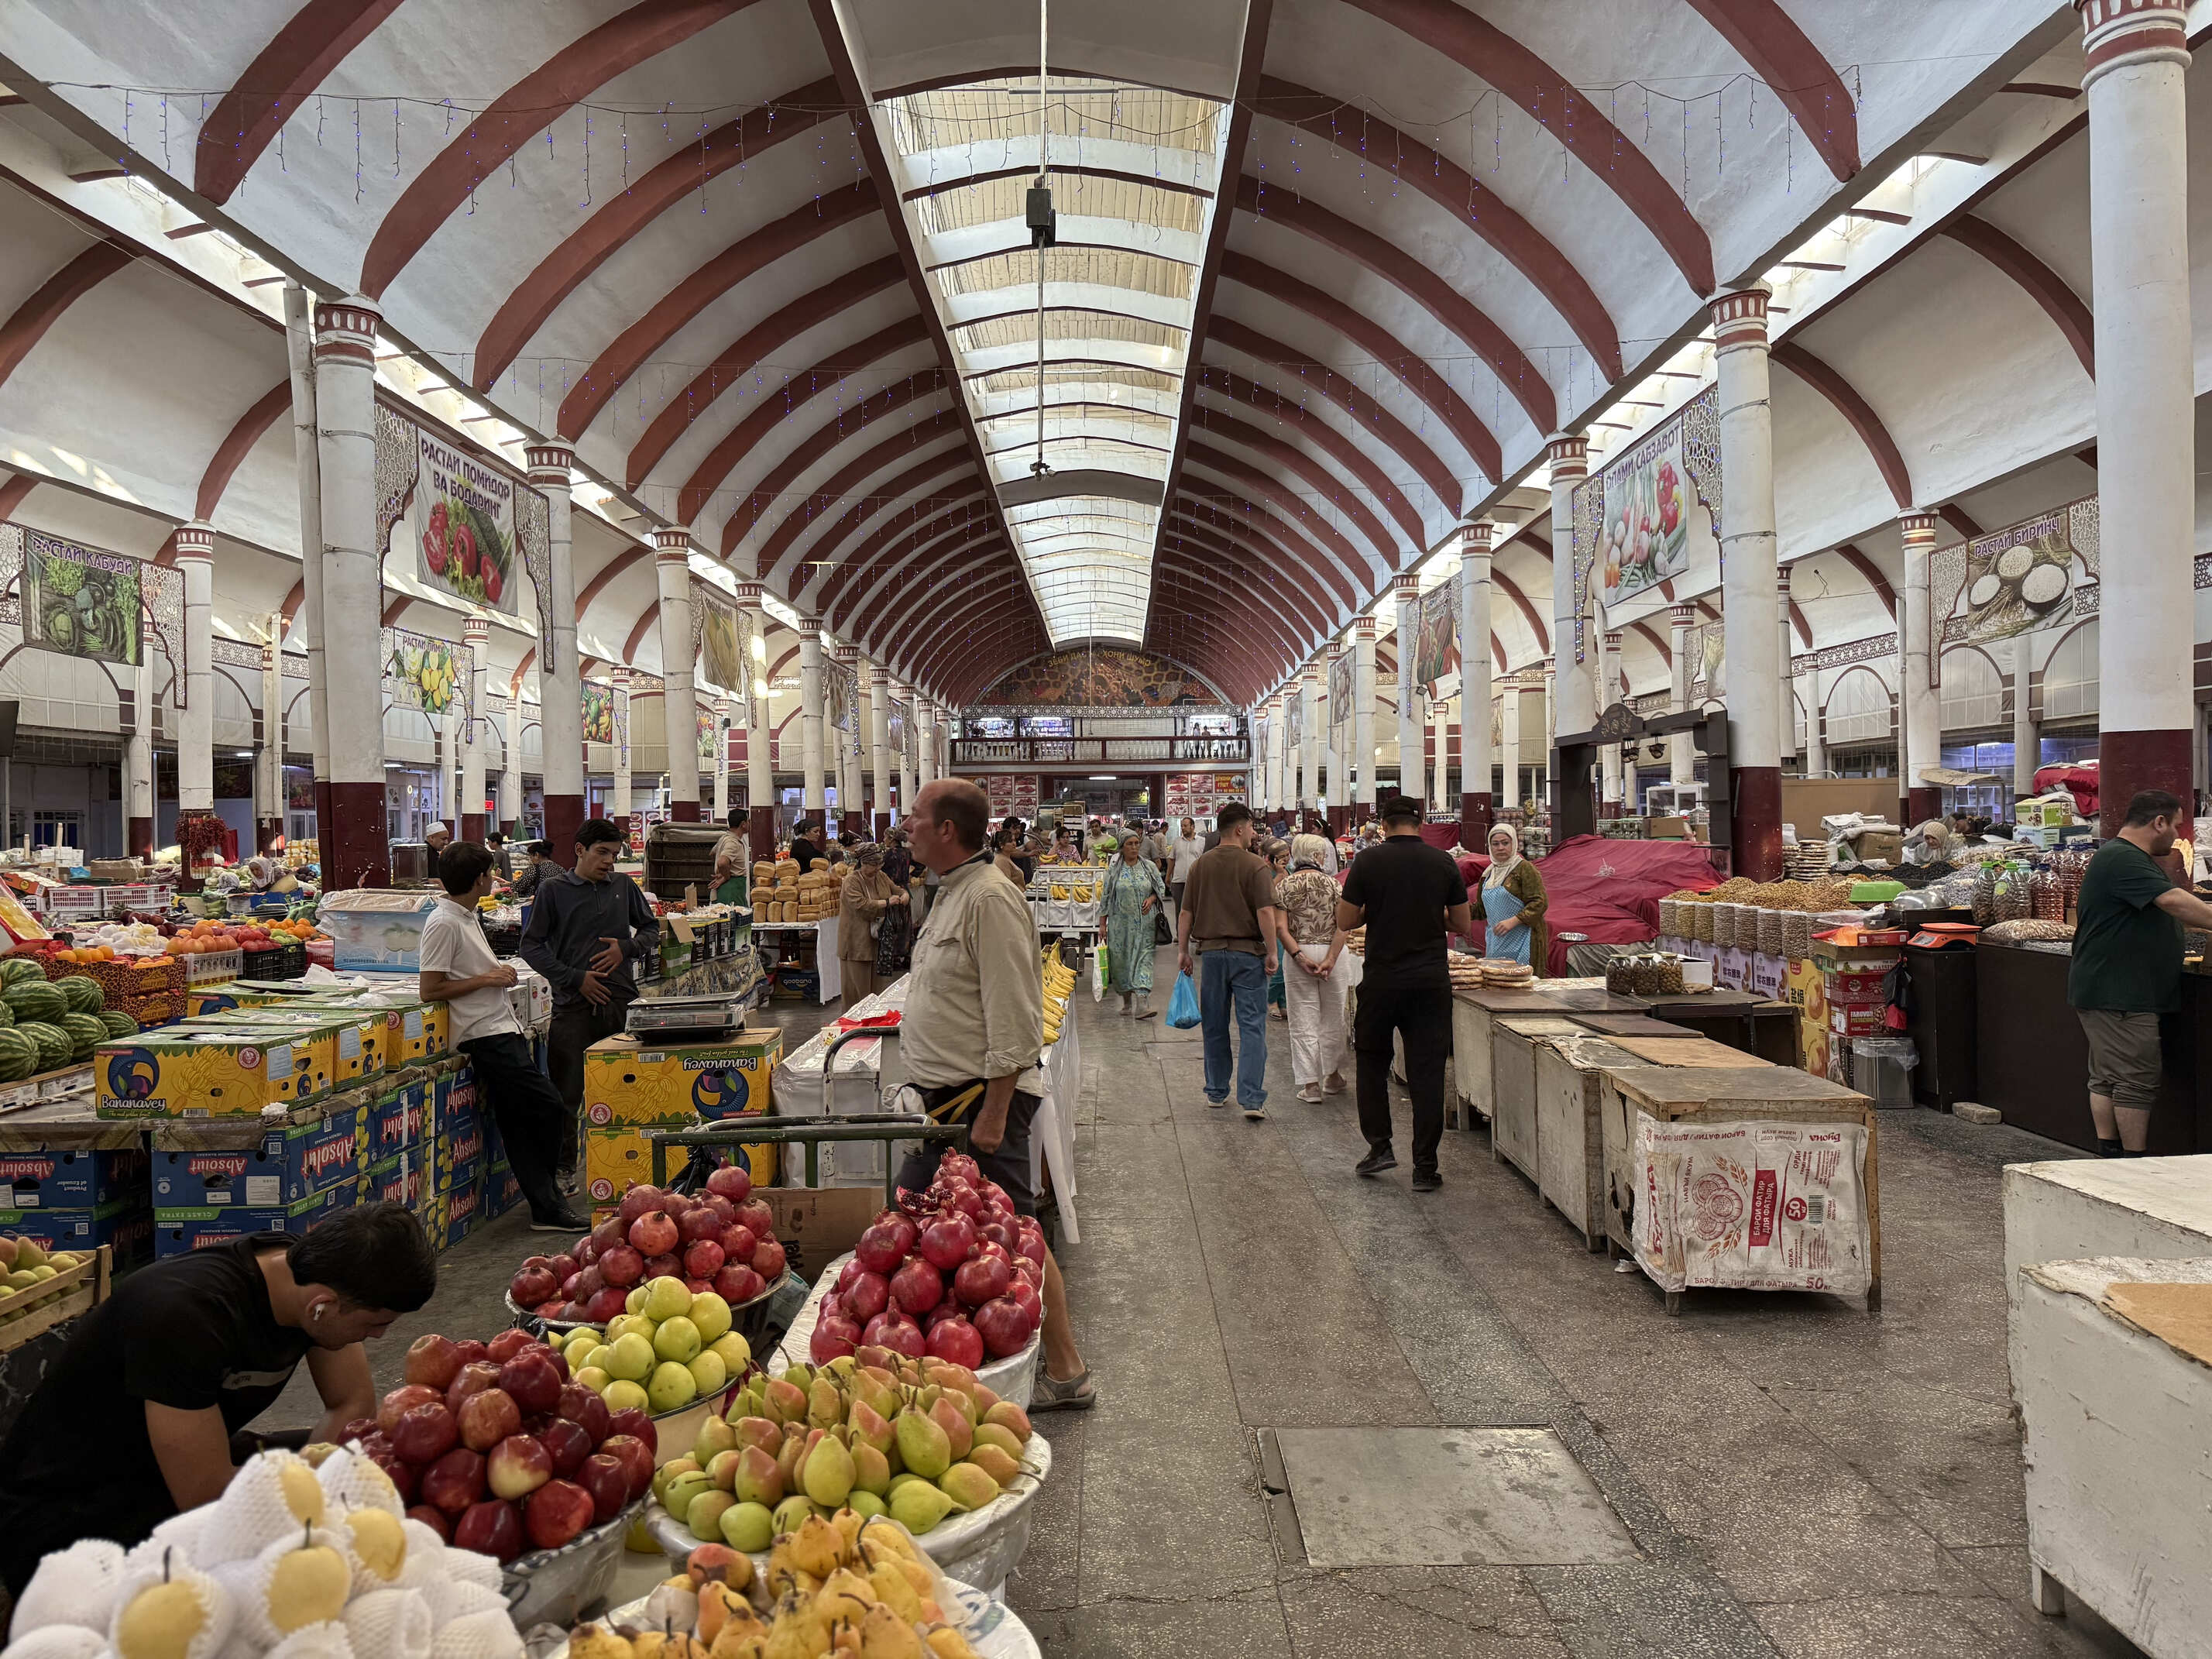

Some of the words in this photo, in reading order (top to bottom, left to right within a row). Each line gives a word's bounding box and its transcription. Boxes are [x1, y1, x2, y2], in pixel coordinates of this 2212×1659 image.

[1636, 424, 1680, 470] САБЗАВОТ
[462, 460, 510, 500] ПОМИДОР
[433, 469, 448, 493] ВА
[450, 477, 502, 520] БОДАРИНГ
[683, 1056, 757, 1071] Bananavey
[101, 1095, 167, 1111] Bananavey
[1721, 1130, 1746, 1140] БАРОИ
[1809, 1132, 1841, 1143] Буона
[191, 1159, 246, 1173] Absolut
[1755, 1180, 1765, 1207] ФАТИР
[1764, 1182, 1774, 1216] ФАТЫРА
[1788, 1200, 1801, 1218] 50
[1753, 1210, 1762, 1236] БАРОИ
[1762, 1218, 1772, 1234] ДЛЯ
[1805, 1276, 1824, 1290] 50
